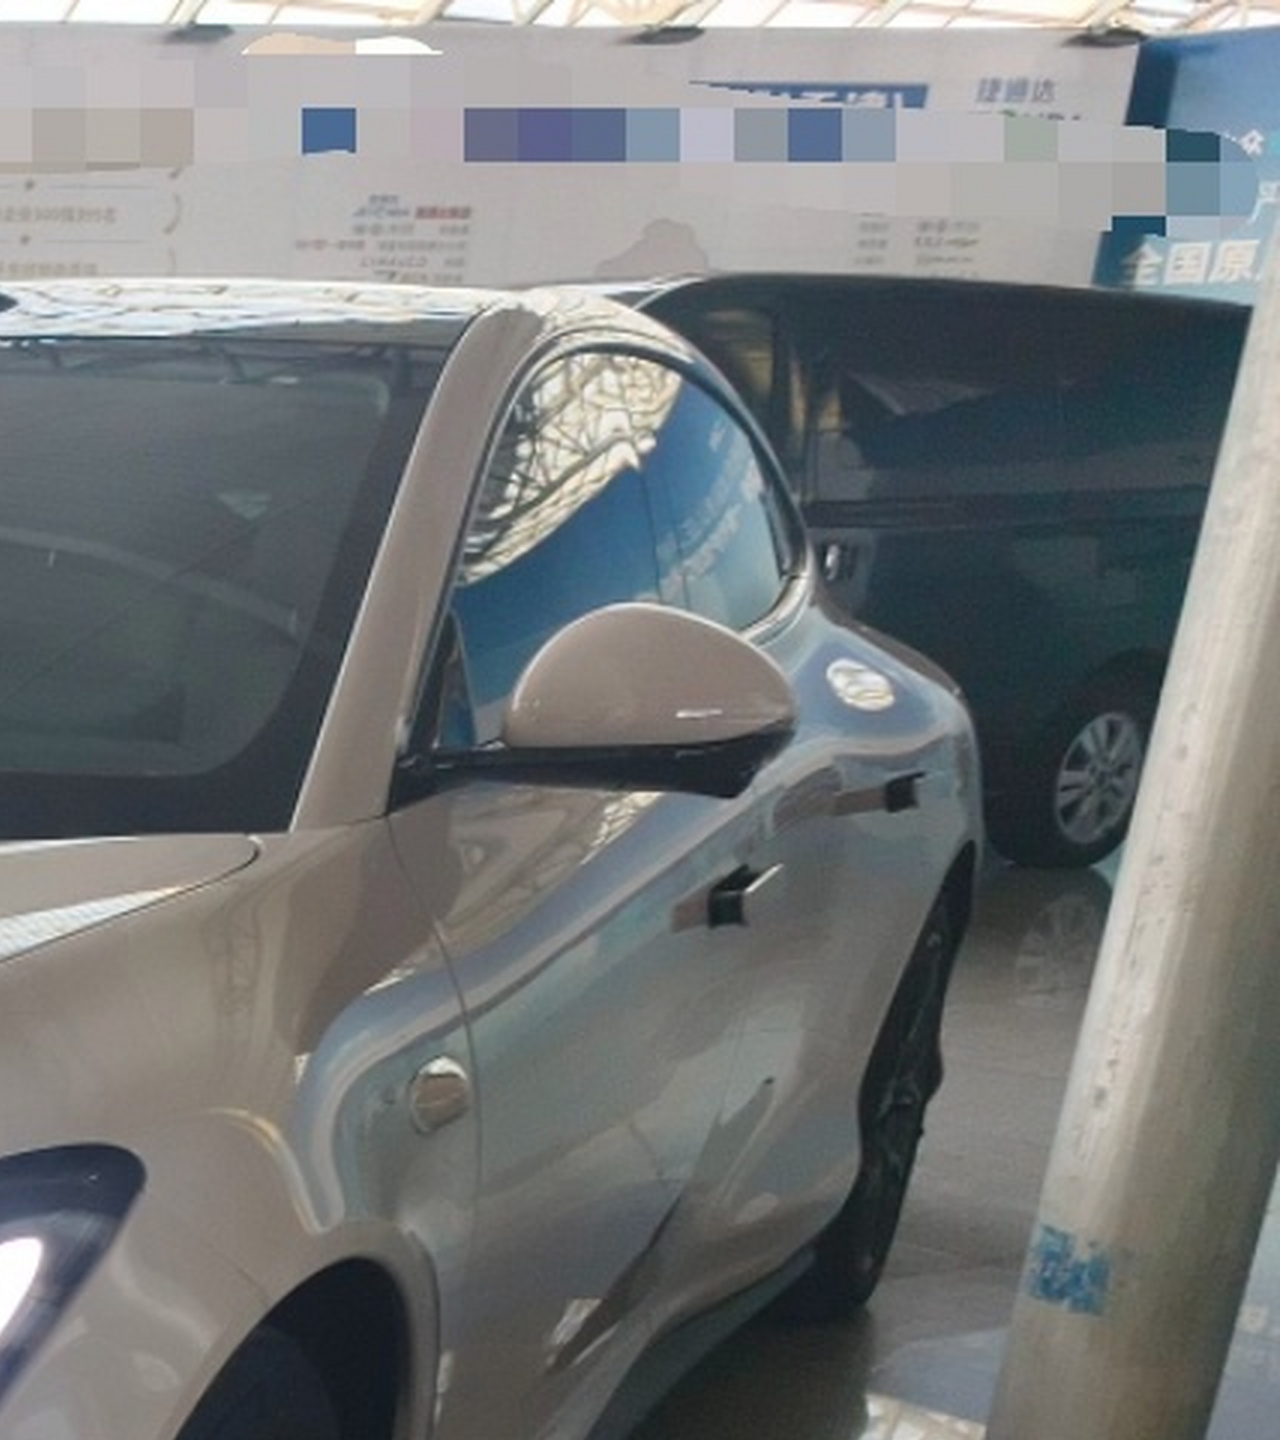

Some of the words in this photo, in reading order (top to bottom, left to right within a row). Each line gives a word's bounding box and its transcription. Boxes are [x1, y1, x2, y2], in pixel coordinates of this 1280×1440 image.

[976, 78, 1056, 103] 捷通达
[1122, 238, 1262, 286] 全国原
